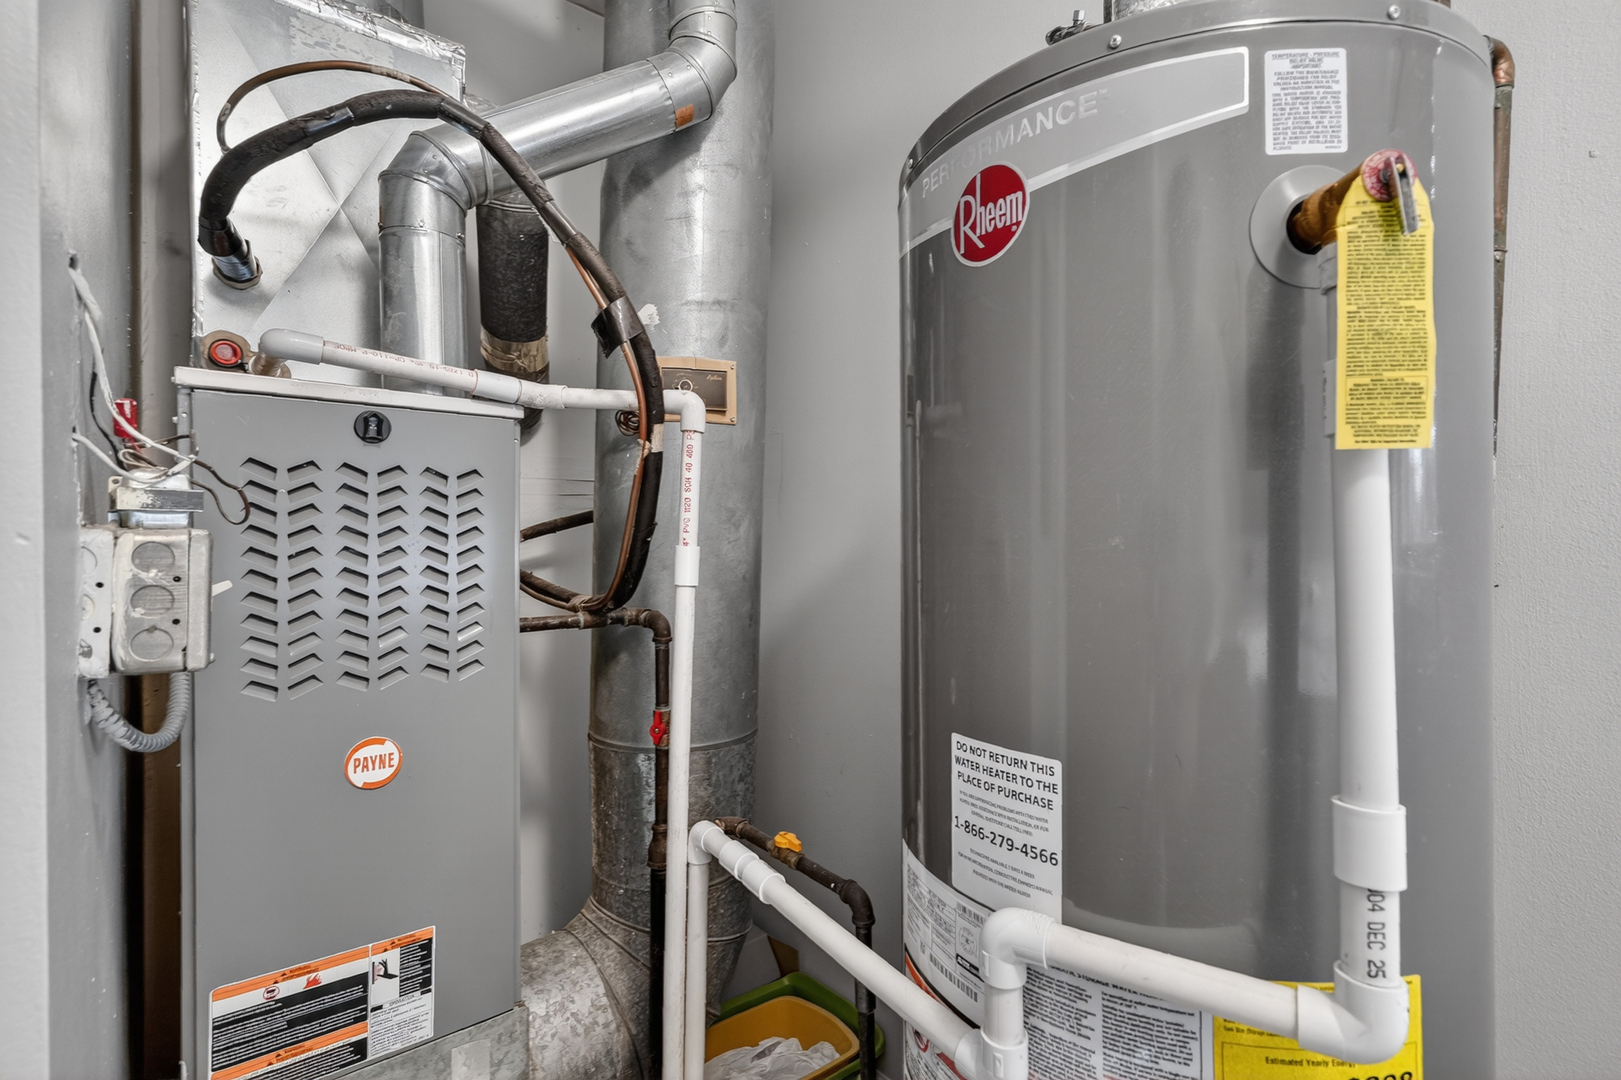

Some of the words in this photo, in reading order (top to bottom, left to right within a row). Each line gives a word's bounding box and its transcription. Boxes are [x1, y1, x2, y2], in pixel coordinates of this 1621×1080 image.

[959, 173, 1023, 255] Rheem
[353, 752, 395, 774] PAYNE
[954, 754, 981, 774] WATER
[982, 764, 1018, 785] HEATER
[1019, 775, 1034, 788] TO
[1035, 780, 1059, 795] THE
[956, 740, 968, 753] DO
[969, 745, 986, 758] NOT
[989, 750, 1028, 771] RETURN
[1030, 761, 1055, 777] THIS
[957, 770, 982, 789] PLACE
[983, 781, 996, 793] OF
[997, 785, 1054, 811] PURCHASE
[954, 815, 1059, 867] 1-866-279-4566
[1366, 922, 1387, 951] DEC
[1366, 959, 1387, 979] 25
[1265, 1056, 1304, 1067] Estimated
[1306, 1055, 1330, 1068] Yearly
